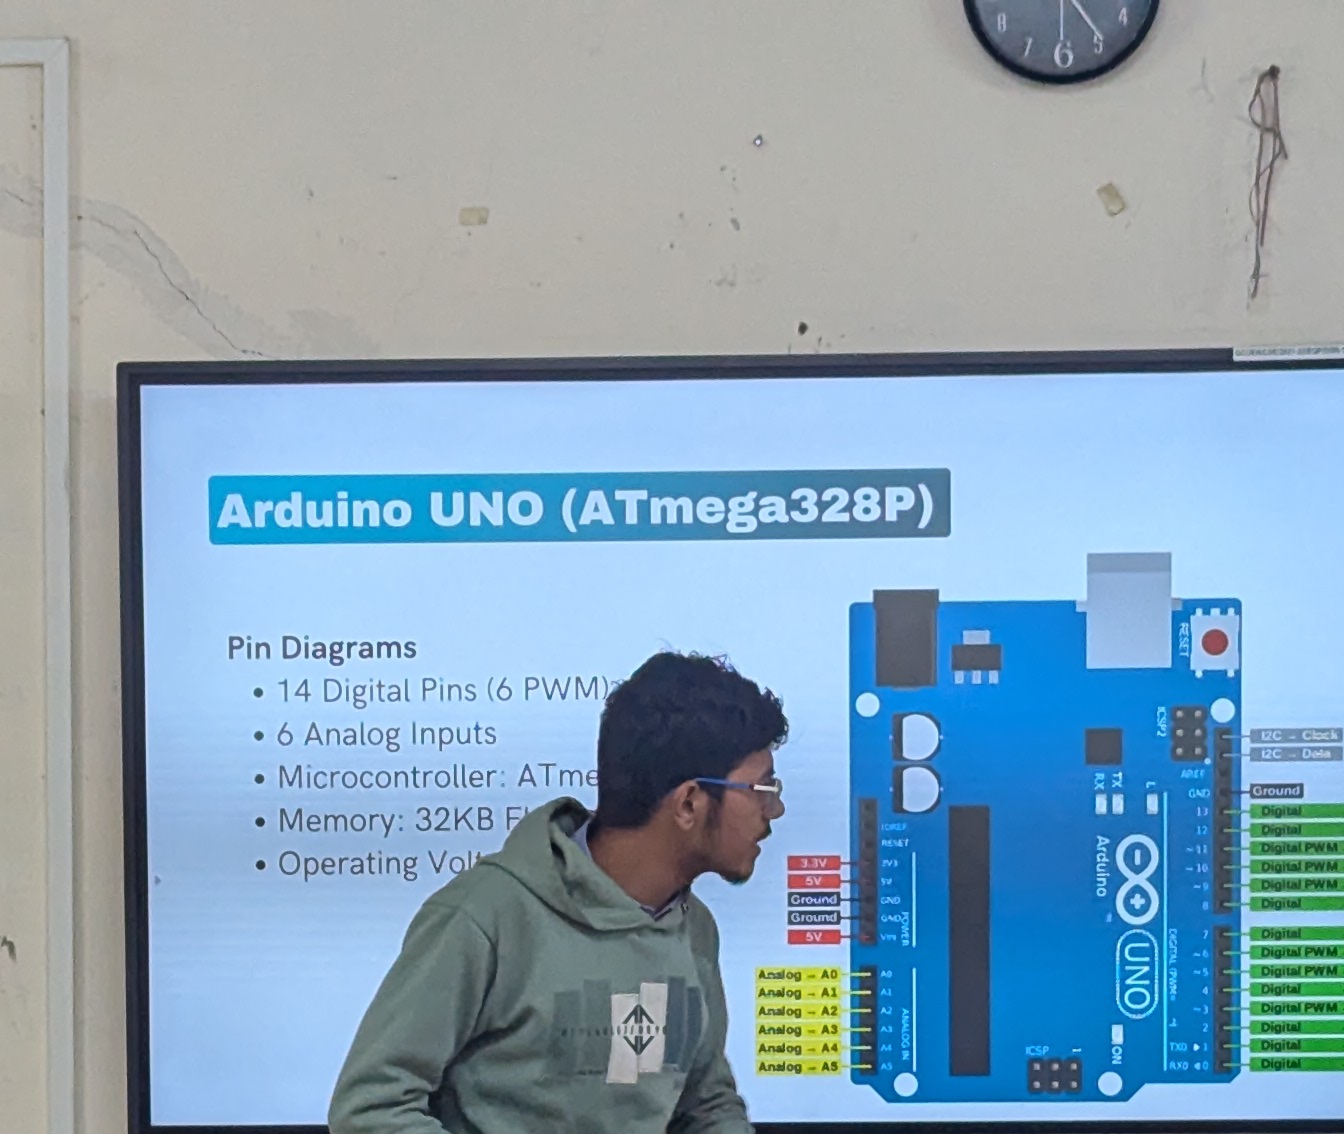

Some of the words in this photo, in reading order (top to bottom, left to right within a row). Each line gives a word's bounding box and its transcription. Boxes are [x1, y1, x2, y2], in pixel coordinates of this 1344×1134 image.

[1054, 41, 1074, 68] 6
[216, 490, 412, 528] Arduino
[430, 490, 544, 527] UNO
[561, 483, 933, 533] (ATmega328P)
[228, 635, 271, 660] Pin
[282, 635, 417, 666] Diagrams
[277, 678, 312, 703] 14
[323, 677, 410, 709] Digital
[421, 677, 477, 702] Pins
[487, 676, 513, 703] (6
[277, 721, 293, 747] 6
[304, 720, 400, 752] Analog
[411, 720, 497, 751] Inputs
[1302, 729, 1338, 741] Clock
[278, 763, 505, 790] Microcontroller:
[517, 762, 599, 788] ATme
[1094, 772, 1105, 790] RX
[1111, 771, 1122, 788] TX
[1252, 785, 1301, 796] Ground
[1261, 805, 1302, 818] Digital
[278, 807, 404, 839] Memory:
[415, 806, 494, 832] 32KB
[1261, 823, 1302, 837] Digital
[1261, 842, 1302, 855] Digital
[1305, 842, 1338, 852] PWM
[278, 849, 418, 882] Operating
[427, 849, 480, 876] Vol
[1096, 835, 1111, 897] Arduino
[1261, 860, 1302, 874] Digital
[1305, 860, 1338, 871] PWM
[805, 876, 822, 886] 5V
[1261, 879, 1302, 892] Digital
[1305, 879, 1338, 889] PWM
[790, 894, 838, 905] Ground
[1261, 897, 1302, 911] Digital
[790, 912, 838, 922] Ground
[805, 931, 823, 942] 5V
[1261, 928, 1302, 941] Digital
[1261, 946, 1302, 959] Digital
[1305, 946, 1338, 957] PWM
[758, 969, 802, 982] Analog
[821, 969, 838, 979] A0
[1124, 942, 1151, 1010] UNO
[1261, 965, 1302, 978] Digital
[1305, 966, 1338, 976] PWM
[758, 987, 802, 1000] Analog
[821, 987, 837, 997] A1
[1261, 983, 1302, 996] Digital
[758, 1006, 802, 1018] Analog
[821, 1006, 838, 1016] A2
[1261, 1002, 1302, 1015] Digital
[1305, 1002, 1338, 1012] PWM
[758, 1024, 802, 1037] Analog
[821, 1024, 838, 1035] A3
[1261, 1021, 1302, 1034] Digital
[758, 1043, 802, 1055] Analog
[821, 1043, 839, 1053] A4
[1261, 1040, 1302, 1052] Digital
[1112, 1046, 1122, 1065] ON
[758, 1061, 802, 1074] Analog
[821, 1061, 838, 1072] A5
[1261, 1058, 1302, 1071] Digital
